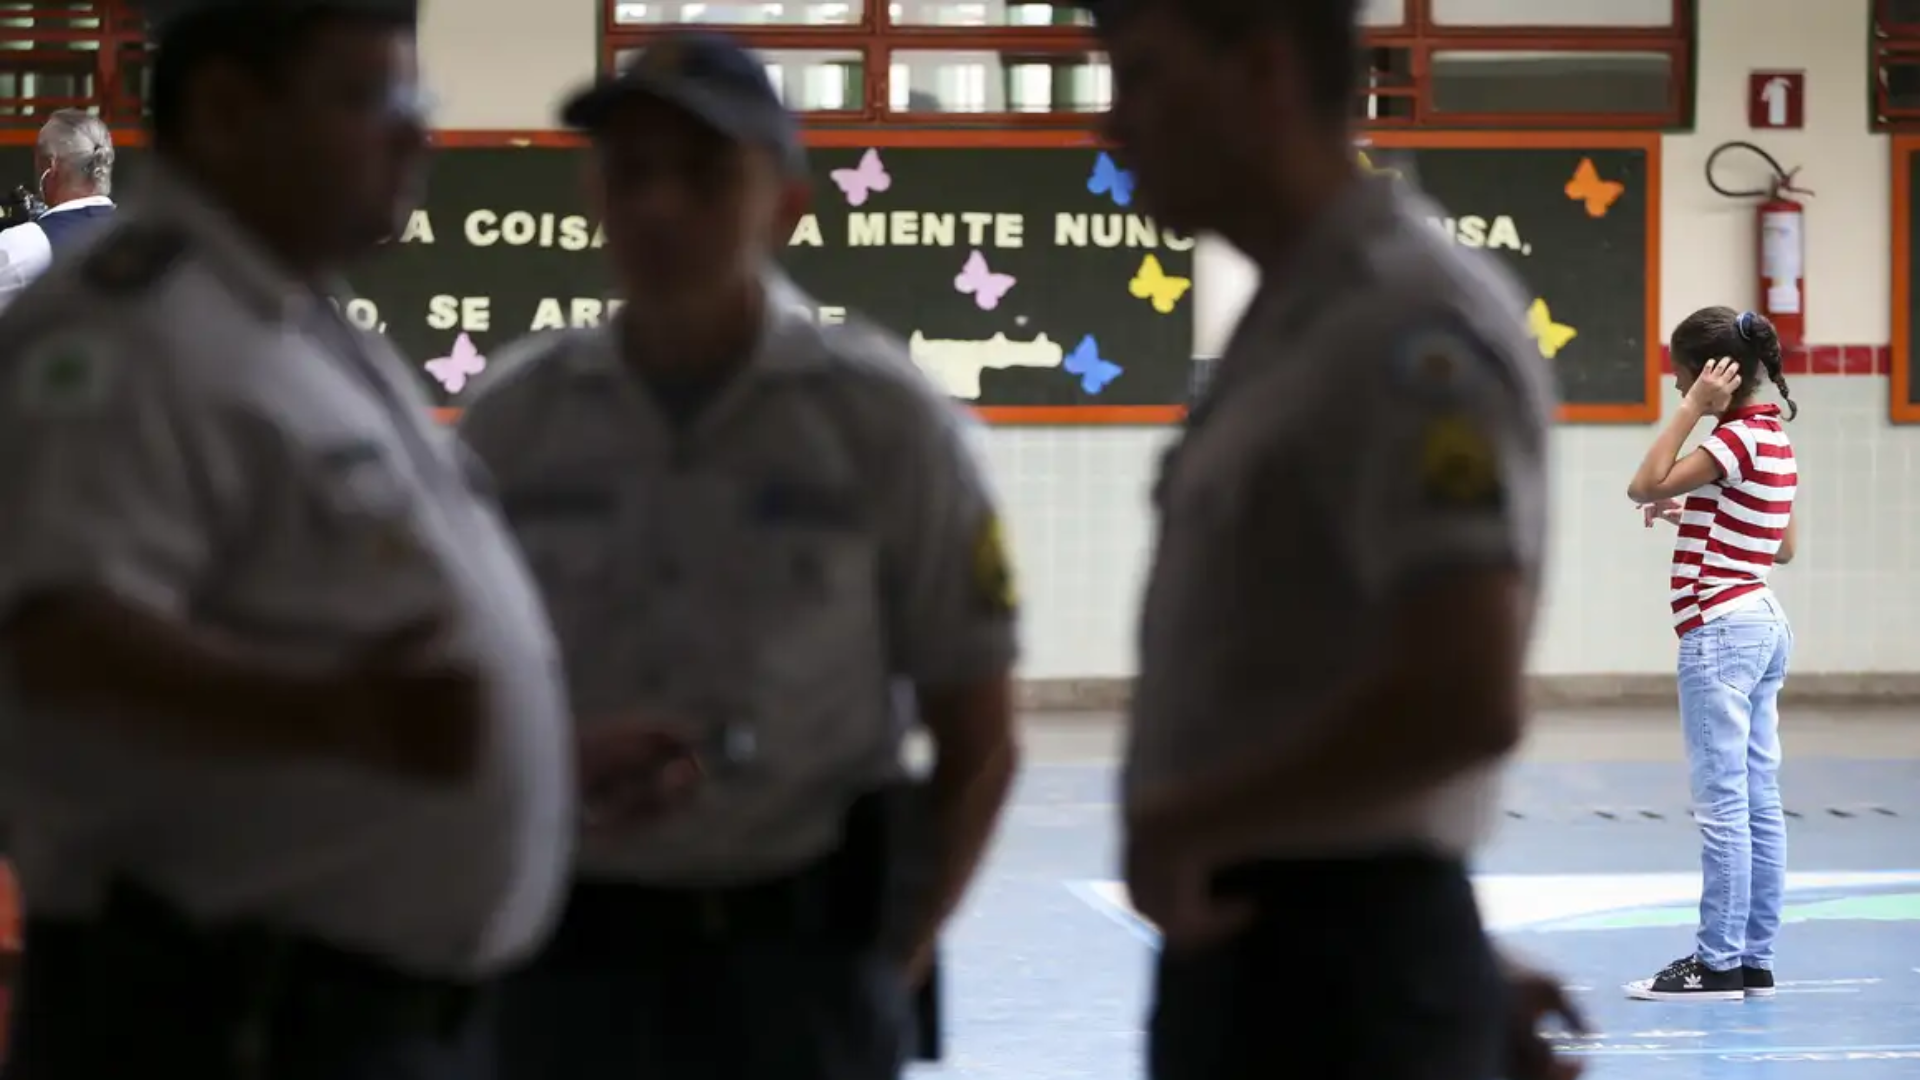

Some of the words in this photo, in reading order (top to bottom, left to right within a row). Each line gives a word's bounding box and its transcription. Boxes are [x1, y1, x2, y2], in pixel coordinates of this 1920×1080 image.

[788, 213, 824, 246] A
[848, 211, 1024, 248] MENTE
[426, 294, 490, 332] SE
